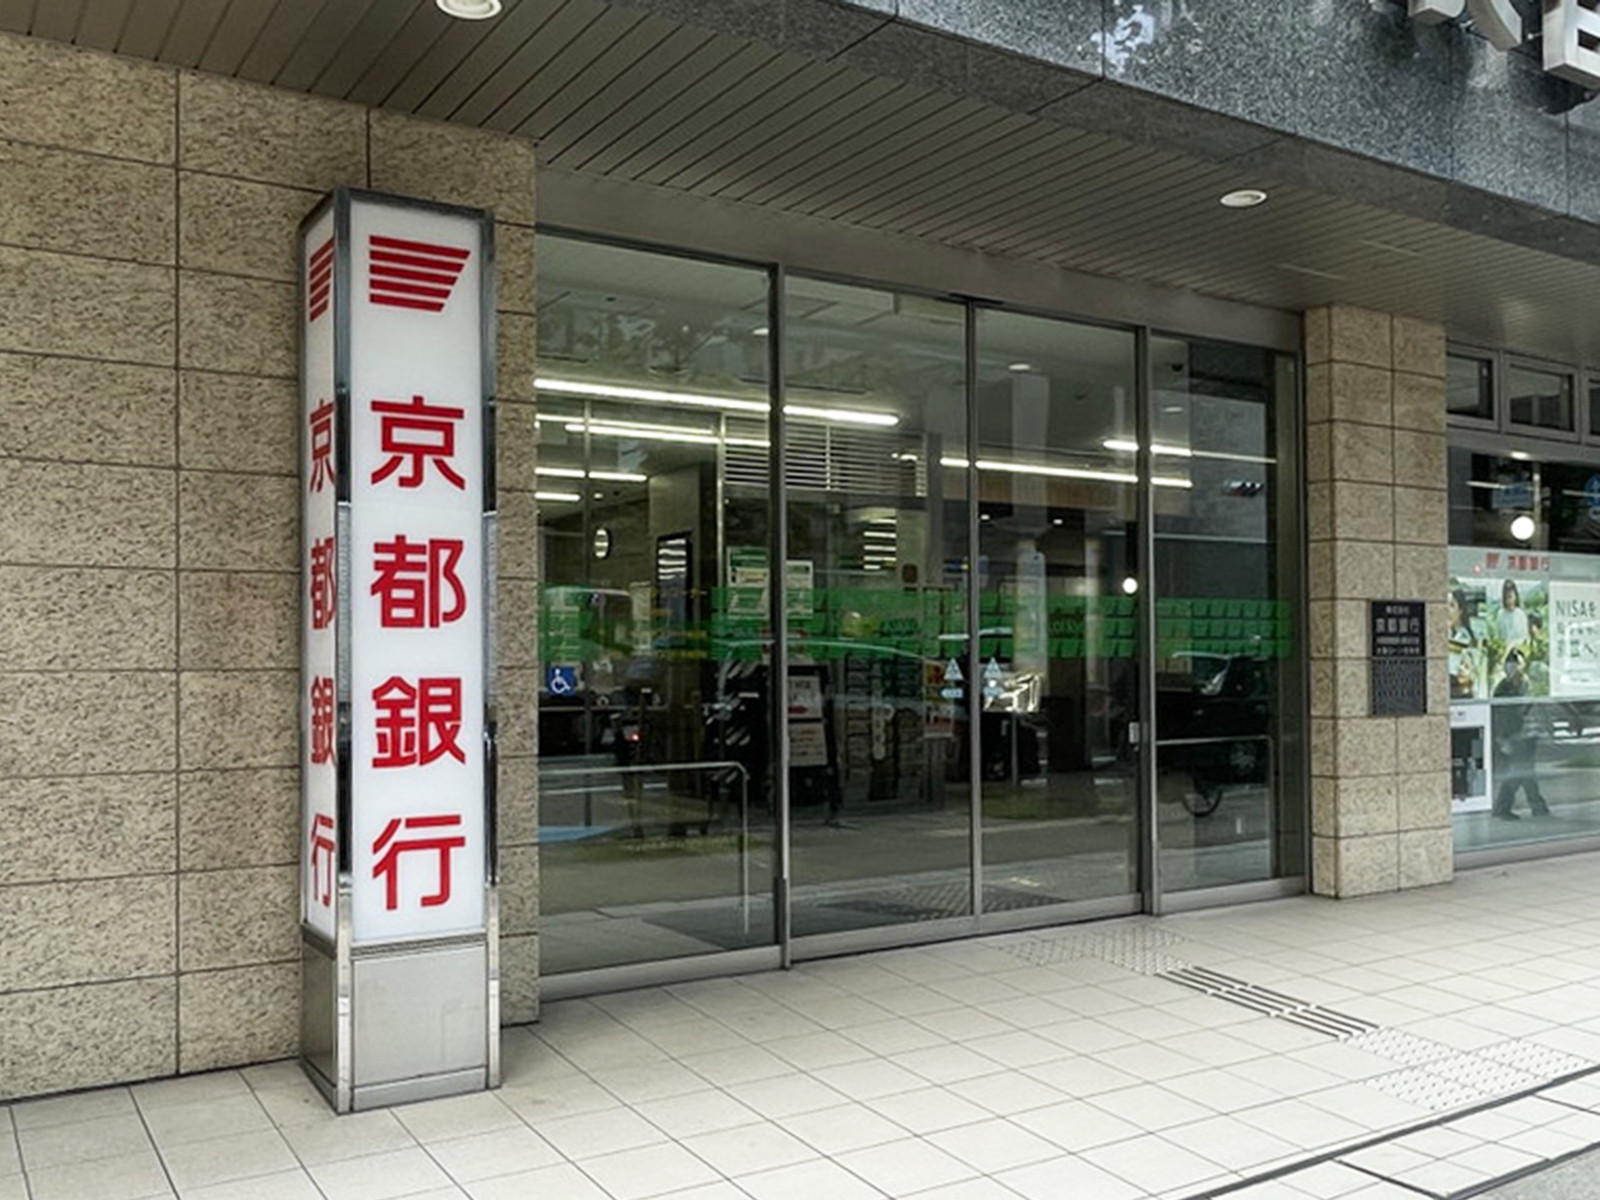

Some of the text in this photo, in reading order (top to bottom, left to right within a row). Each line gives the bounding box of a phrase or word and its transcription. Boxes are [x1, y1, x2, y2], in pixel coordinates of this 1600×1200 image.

[310, 398, 335, 907] 京都銀行
[370, 395, 467, 911] 京都銀行
